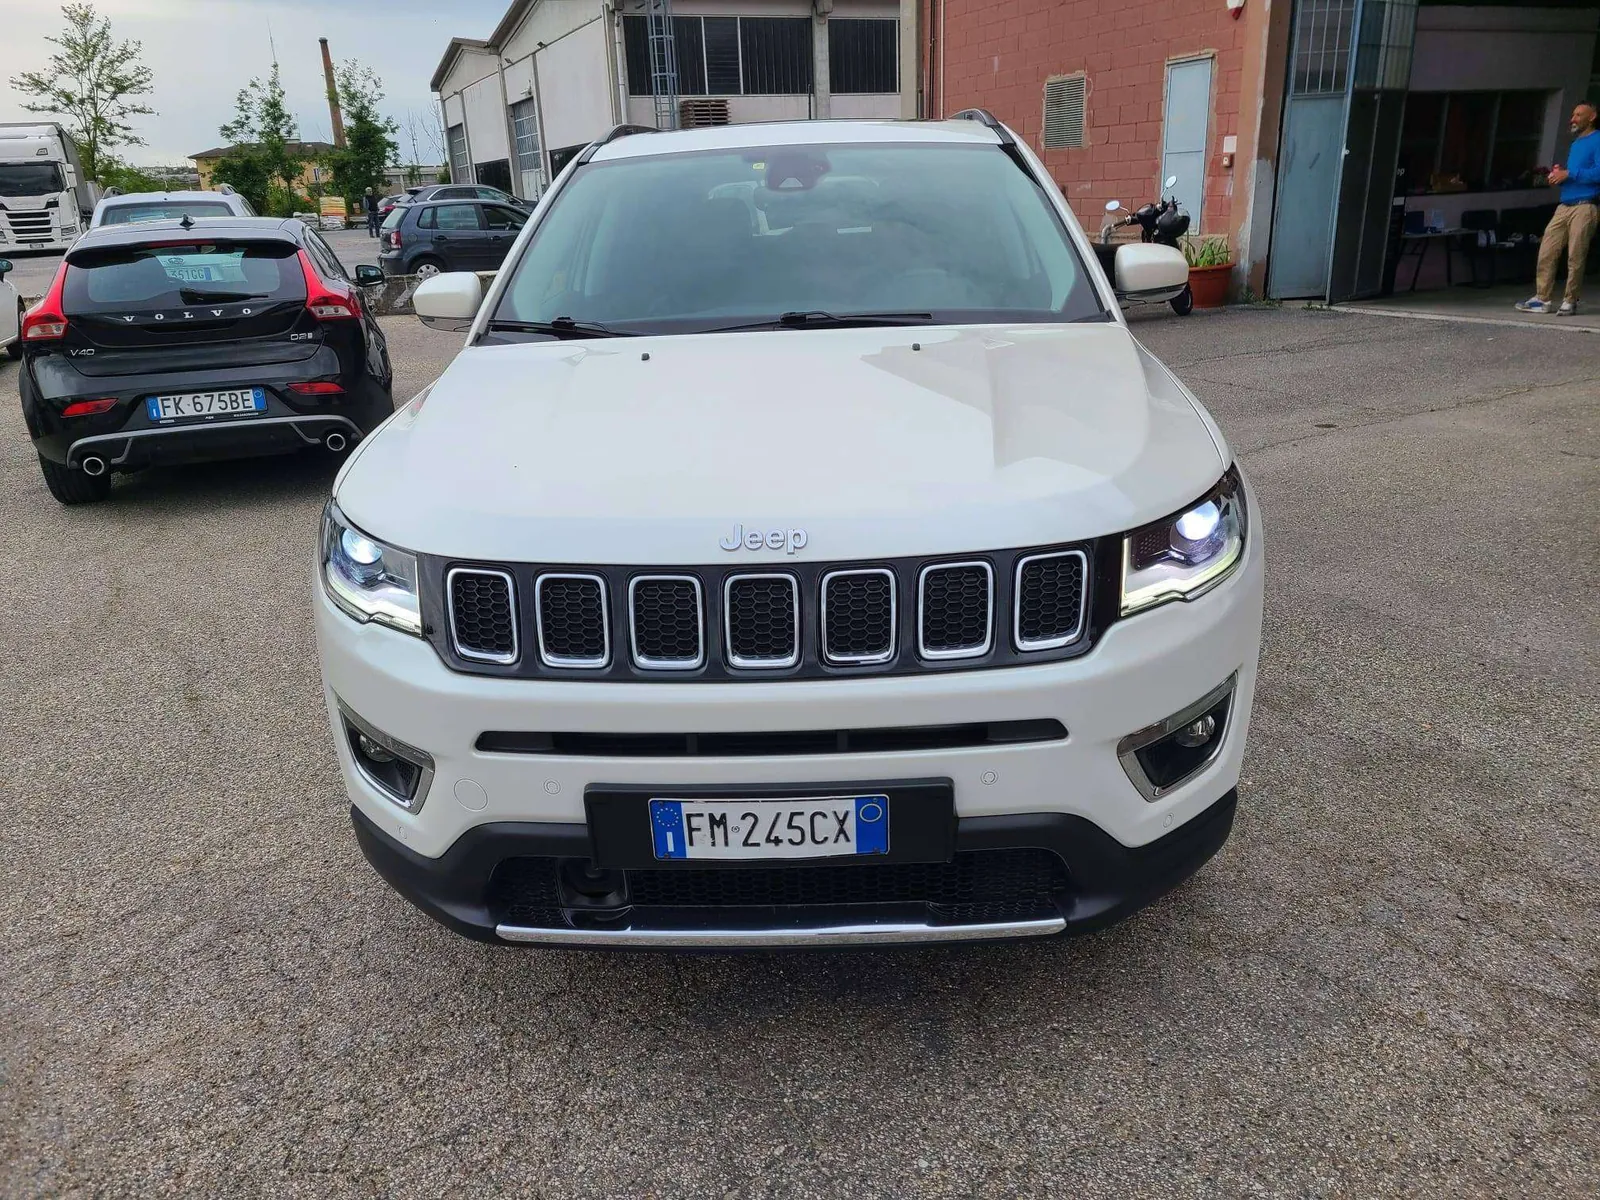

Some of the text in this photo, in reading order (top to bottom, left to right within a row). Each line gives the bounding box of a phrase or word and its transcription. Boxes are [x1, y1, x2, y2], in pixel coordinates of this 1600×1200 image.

[123, 308, 251, 322] VOLVO
[160, 396, 185, 416] FK
[192, 391, 253, 413] 675BE
[719, 522, 808, 556] Jeep
[685, 812, 730, 848] FM
[740, 810, 851, 848] 245CX
